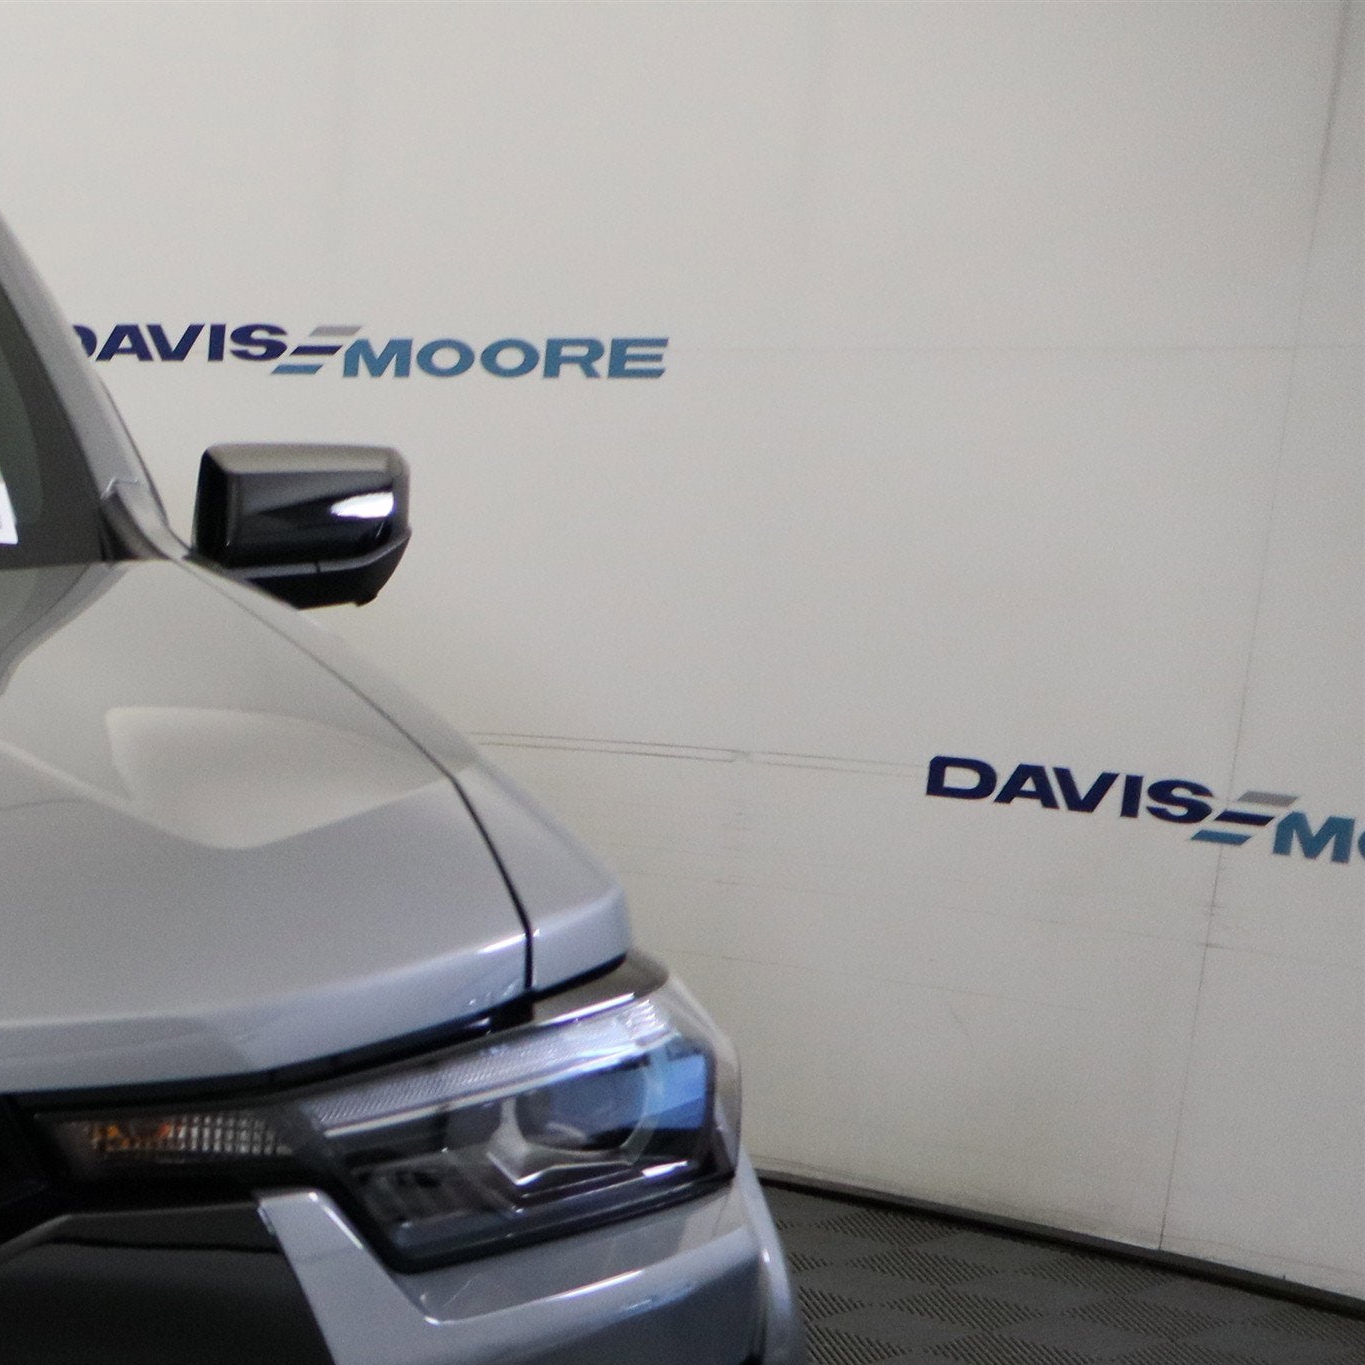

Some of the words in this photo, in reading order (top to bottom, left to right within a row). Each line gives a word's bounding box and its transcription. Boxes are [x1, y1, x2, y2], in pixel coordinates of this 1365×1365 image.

[342, 337, 670, 379] MOORE
[925, 754, 1214, 825] DAVIS
[1272, 810, 1365, 865] M
